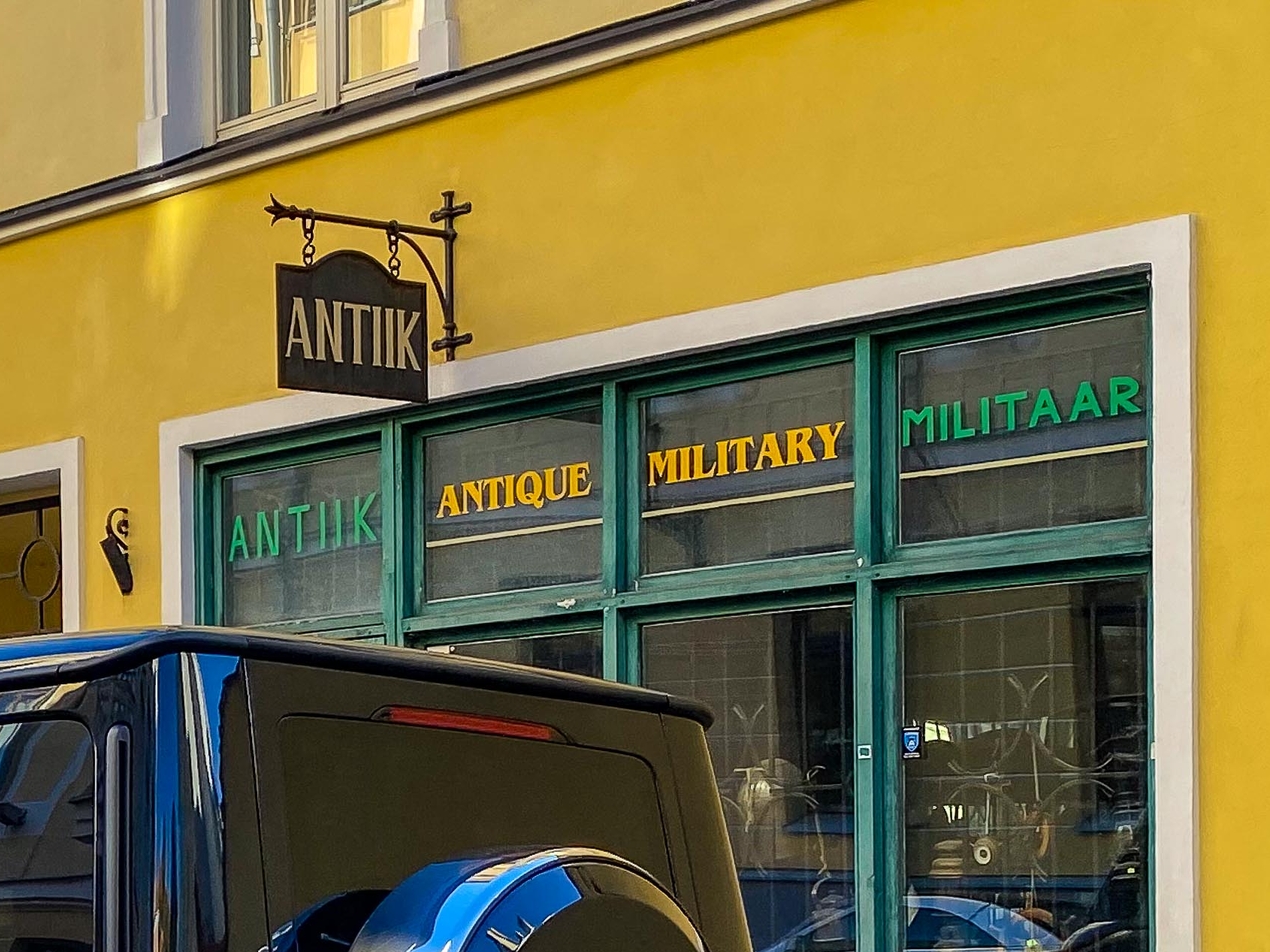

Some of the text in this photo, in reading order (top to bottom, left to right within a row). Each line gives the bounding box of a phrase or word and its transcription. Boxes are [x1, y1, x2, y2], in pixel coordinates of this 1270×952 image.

[285, 296, 421, 371] ANTIIK
[902, 376, 1142, 447] MILITAAR
[647, 421, 845, 487] MILITARY
[436, 462, 593, 518] ANTIQUE
[228, 492, 377, 562] ANTIIK
